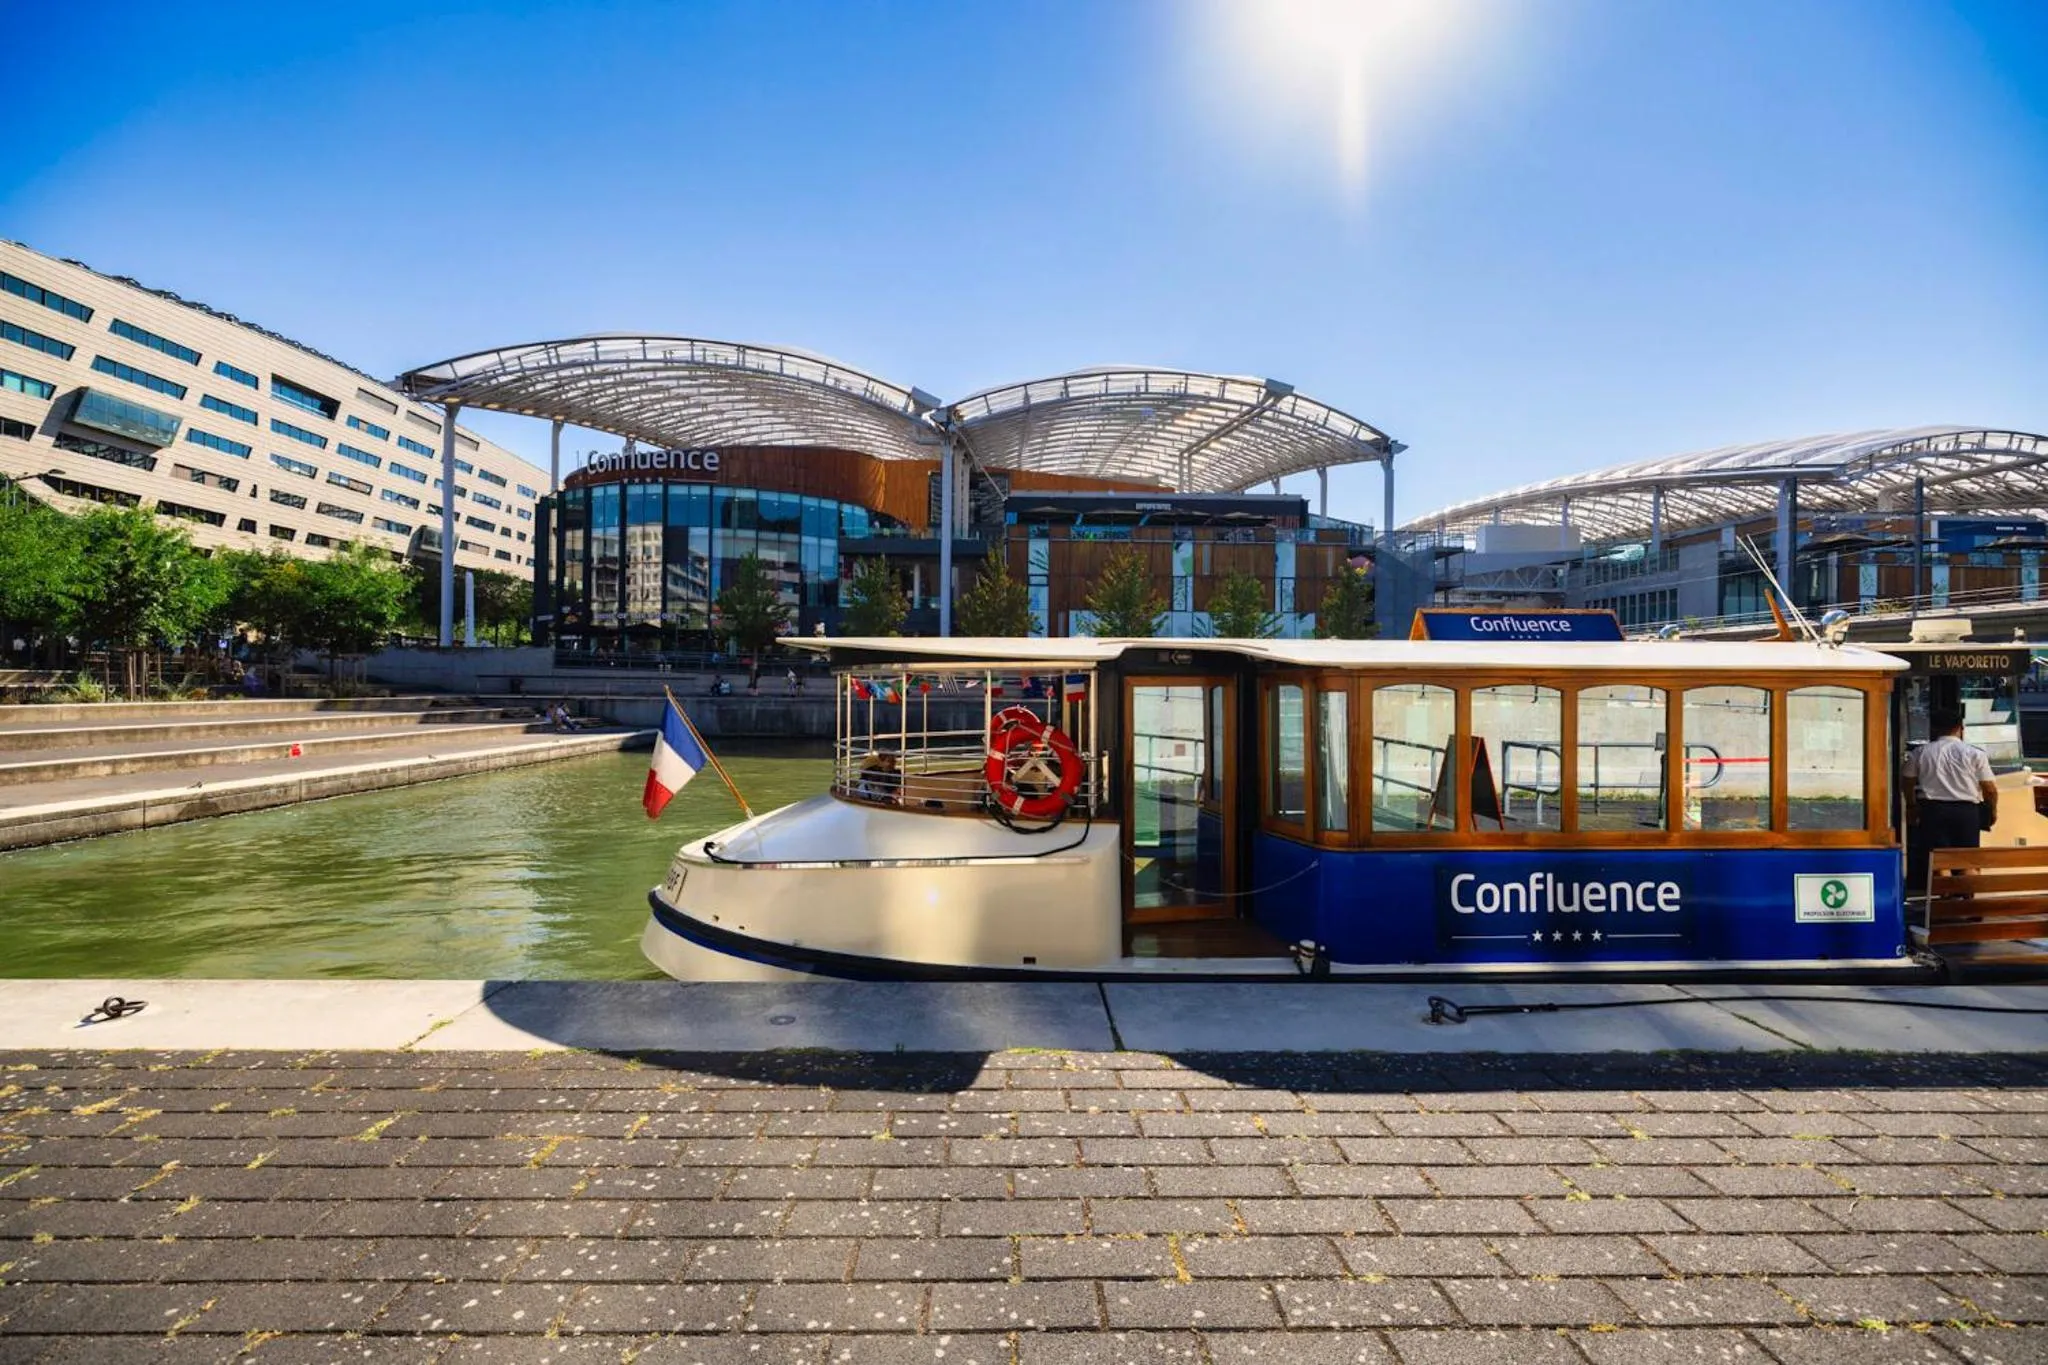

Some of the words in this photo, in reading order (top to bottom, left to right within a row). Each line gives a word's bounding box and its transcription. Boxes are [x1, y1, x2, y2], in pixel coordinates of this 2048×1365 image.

[586, 447, 720, 475] Confluence
[1469, 615, 1572, 632] Confluence
[1929, 654, 1941, 669] LE
[1944, 654, 2011, 669] VAPORETTO
[1450, 871, 1682, 914] Confluence
